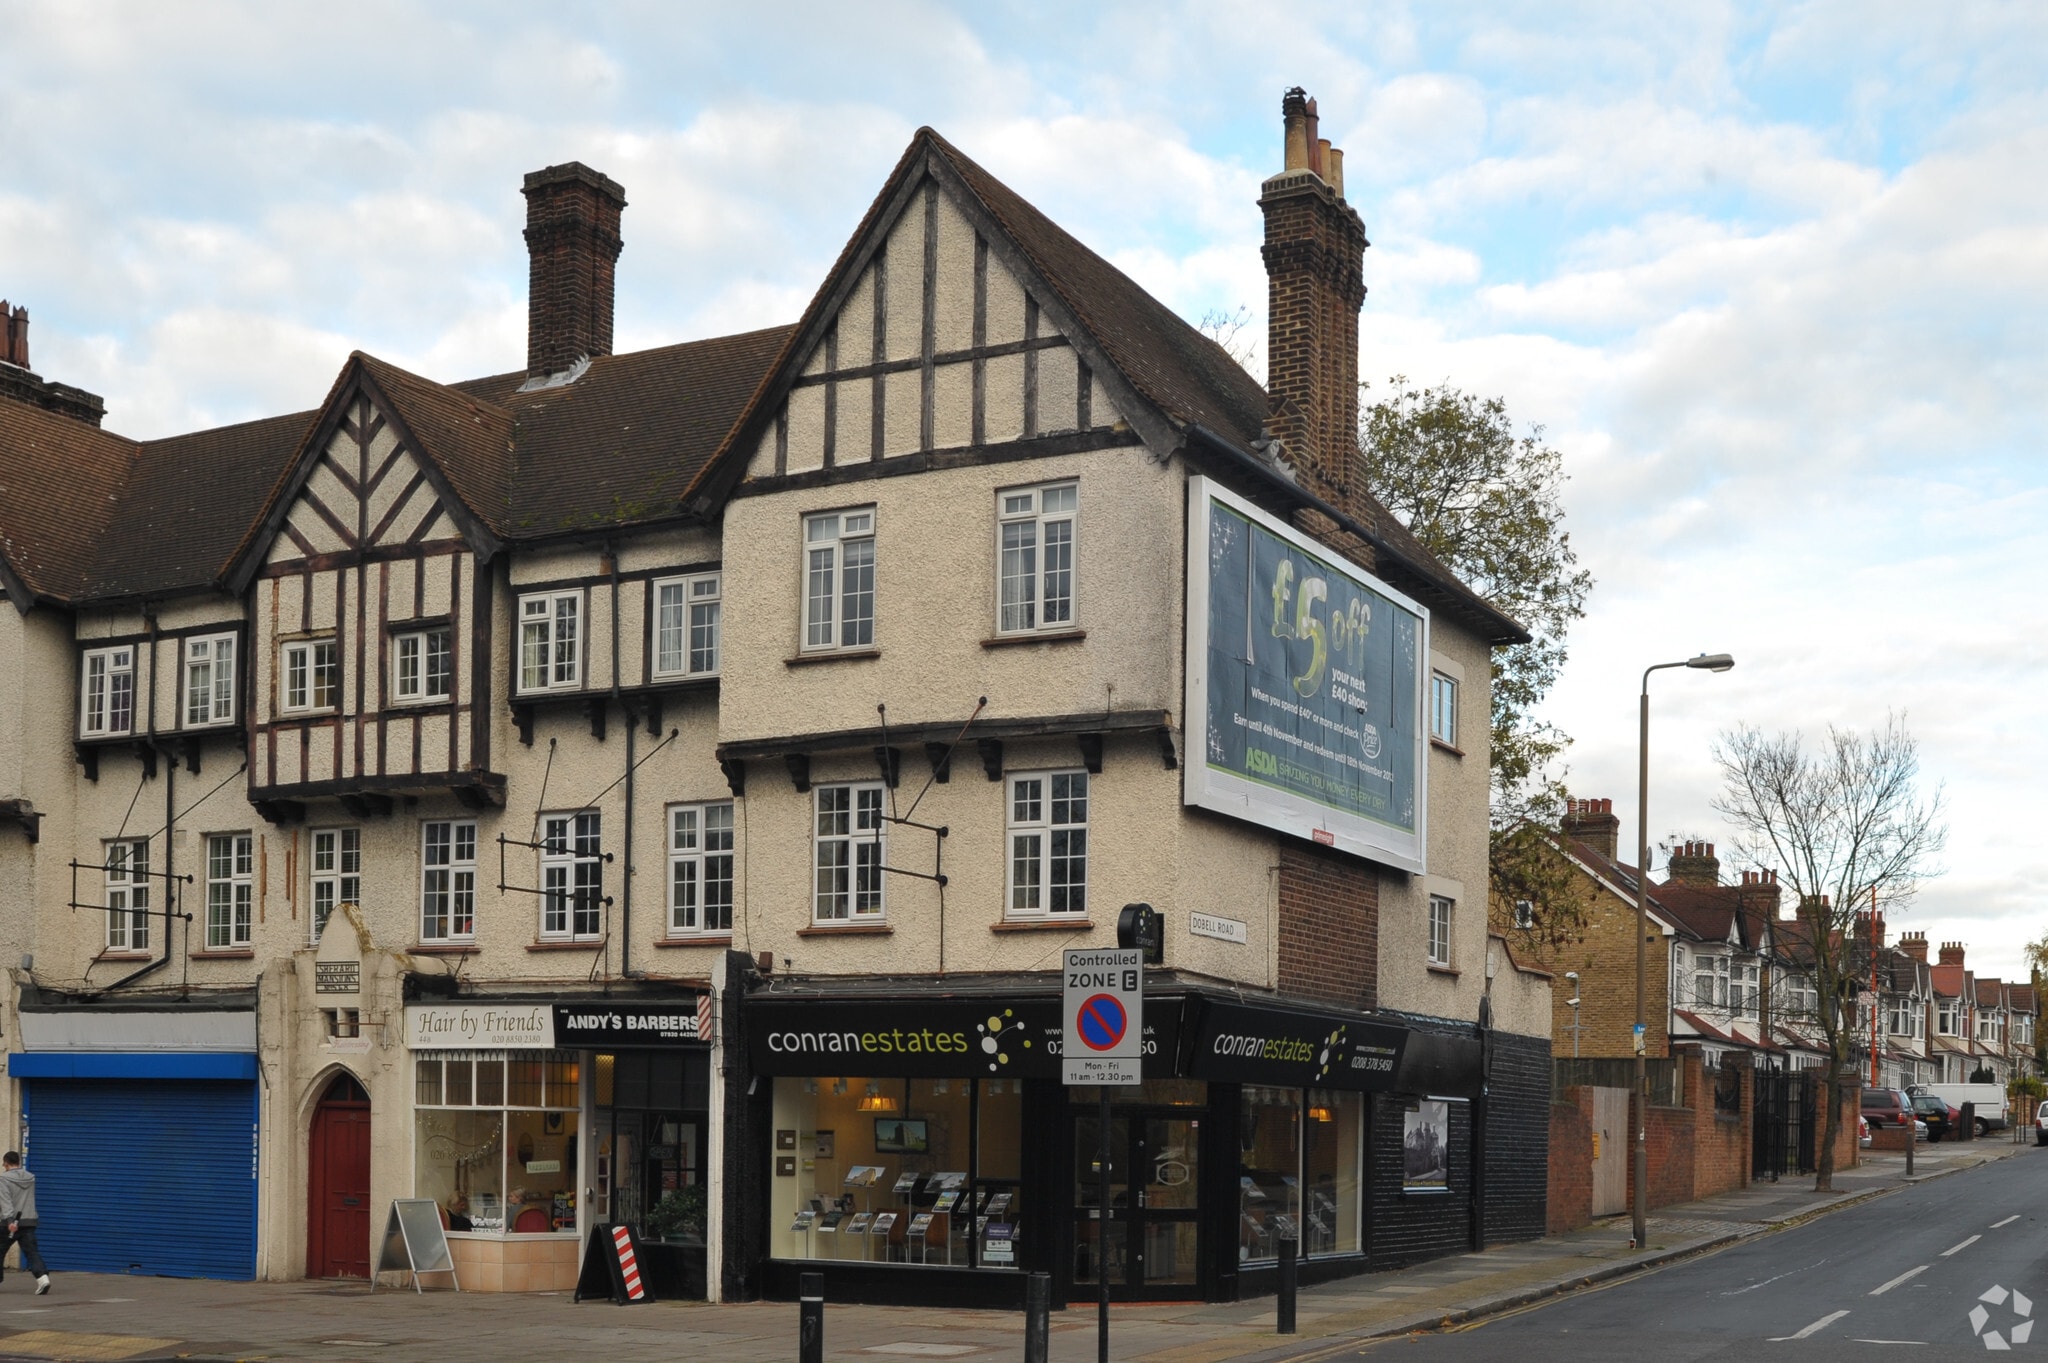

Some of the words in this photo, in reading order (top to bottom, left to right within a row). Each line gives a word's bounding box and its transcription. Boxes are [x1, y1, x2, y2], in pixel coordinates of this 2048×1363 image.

[1271, 559, 1327, 698] £5
[1332, 598, 1371, 671] off
[1331, 667, 1349, 685] your
[1350, 676, 1366, 693] next
[1331, 684, 1347, 702] £40
[1251, 686, 1269, 702] When
[1269, 695, 1280, 707] you
[1281, 700, 1298, 715] spend
[1313, 714, 1319, 723] or
[1320, 717, 1333, 729] more
[1334, 722, 1343, 733] and
[1344, 725, 1359, 739] check
[1233, 712, 1248, 727] Earn
[1248, 720, 1262, 733] until
[1262, 724, 1273, 737] 4th
[1273, 728, 1303, 747] November
[1303, 740, 1313, 752] and
[1314, 744, 1334, 760] redeem
[1334, 752, 1346, 765] until
[1358, 760, 1382, 778] November
[1246, 746, 1278, 778] ASDA
[1279, 763, 1309, 783] SAVING
[1310, 773, 1325, 789] YOU
[1326, 781, 1350, 797] MONEY
[1351, 788, 1373, 805] EVERY
[1372, 796, 1386, 810] DAY
[1193, 917, 1216, 932] DOBELL
[1218, 922, 1234, 936] ROAD
[1069, 953, 1138, 967] Controlled
[1068, 973, 1117, 988] ZONE
[1124, 972, 1136, 989] E
[418, 1011, 456, 1033] Hair
[461, 1008, 478, 1040] by
[483, 1007, 544, 1032] Friends
[566, 1011, 622, 1030] ANDY'S
[626, 1015, 699, 1031] BARBERS
[492, 1035, 505, 1043] 020
[505, 1035, 522, 1043] 8850
[1084, 1062, 1102, 1070] Mon
[1108, 1062, 1119, 1070] Fri
[1351, 1056, 1367, 1069] 0208
[1366, 1057, 1379, 1071] 378
[1377, 1058, 1393, 1072] 5450
[1096, 1073, 1119, 1081] 12.30
[1120, 1074, 1133, 1083] pm
